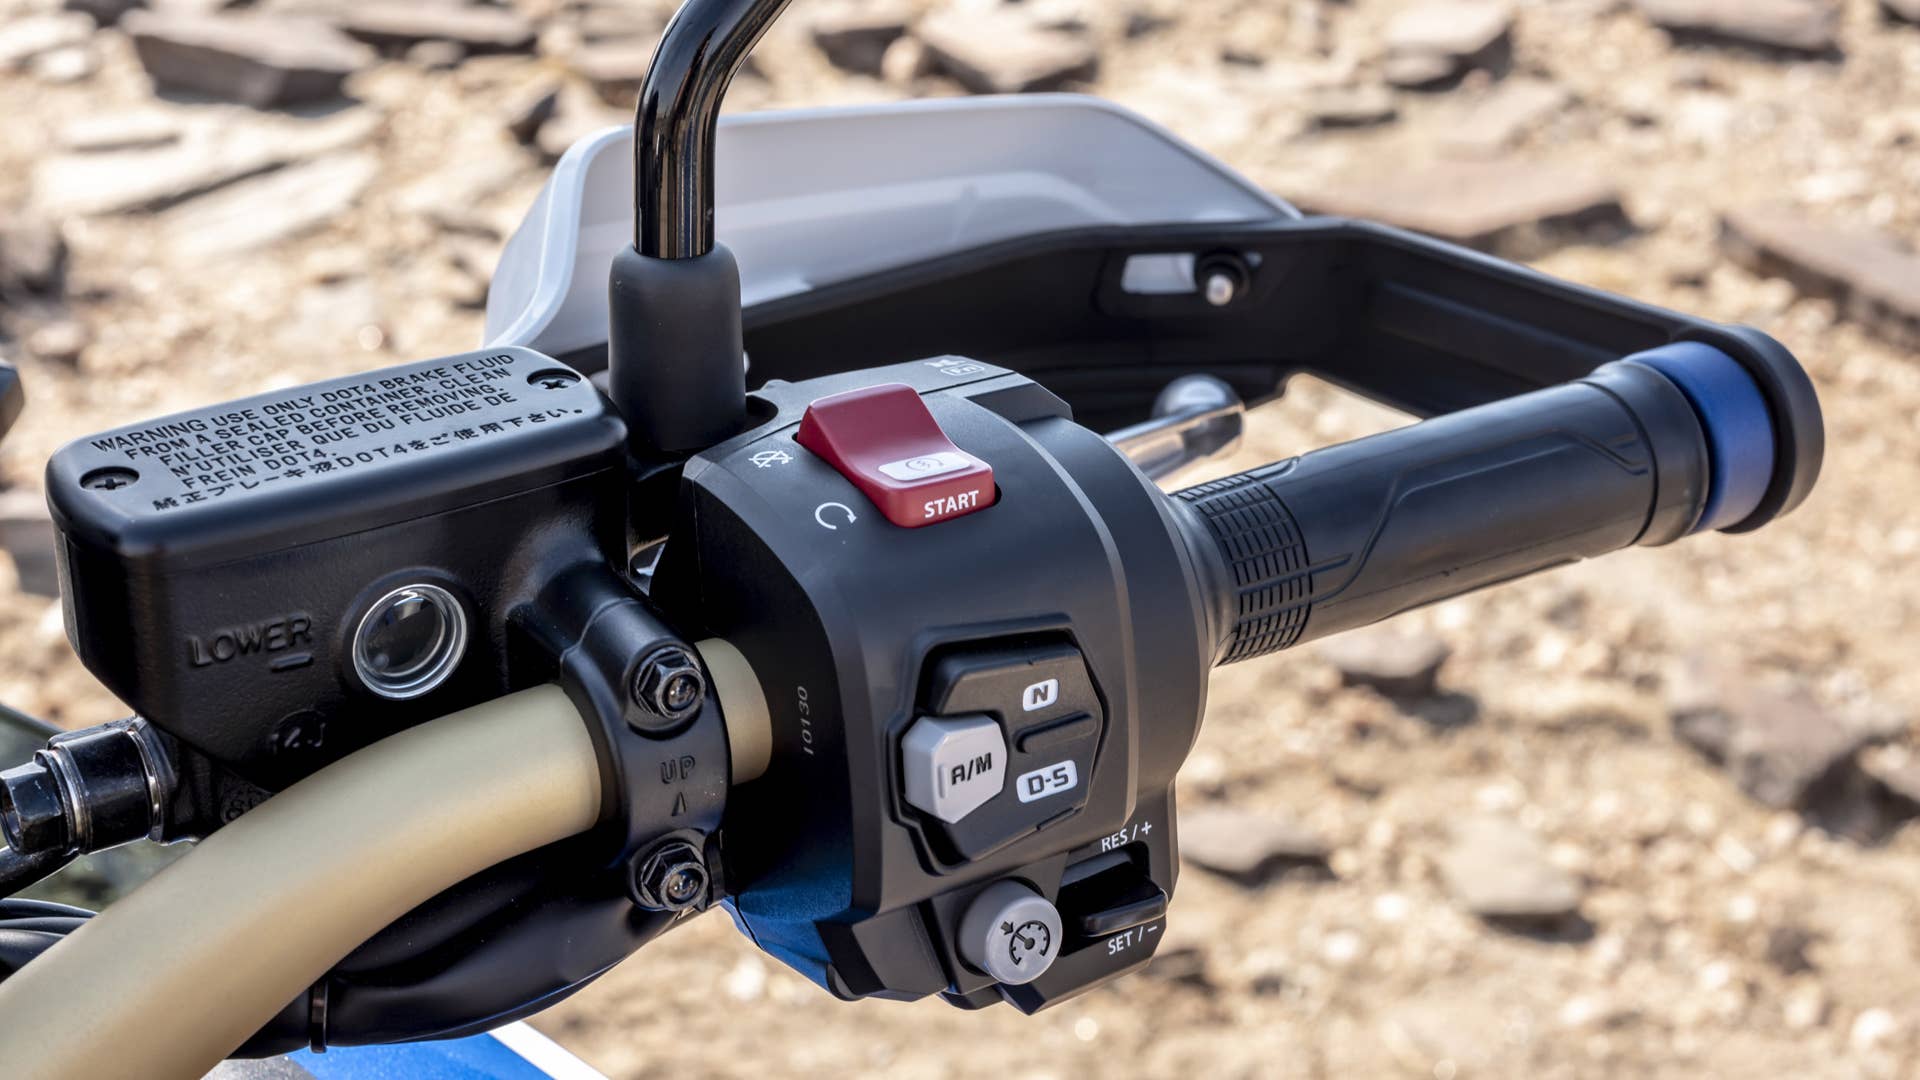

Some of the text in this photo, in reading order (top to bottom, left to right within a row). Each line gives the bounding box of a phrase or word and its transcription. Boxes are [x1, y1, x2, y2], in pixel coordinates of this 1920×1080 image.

[91, 354, 515, 452] WARNING USE ONLY DOT4 BRAKE FLUID
[124, 368, 512, 460] FROM A SEALED CONTAINER. CLEAN
[159, 384, 504, 466] FILLER CAP BEFORE REMOVING.
[170, 392, 518, 477] N'UTILISER QUE DU FLUIDE DE
[181, 449, 337, 489] FREIN DOT4.
[923, 489, 979, 519] START
[189, 612, 312, 667] LOWER
[1033, 685, 1048, 704] N
[660, 755, 696, 784] UP
[951, 752, 992, 785] A/M
[1027, 767, 1069, 795] D-S
